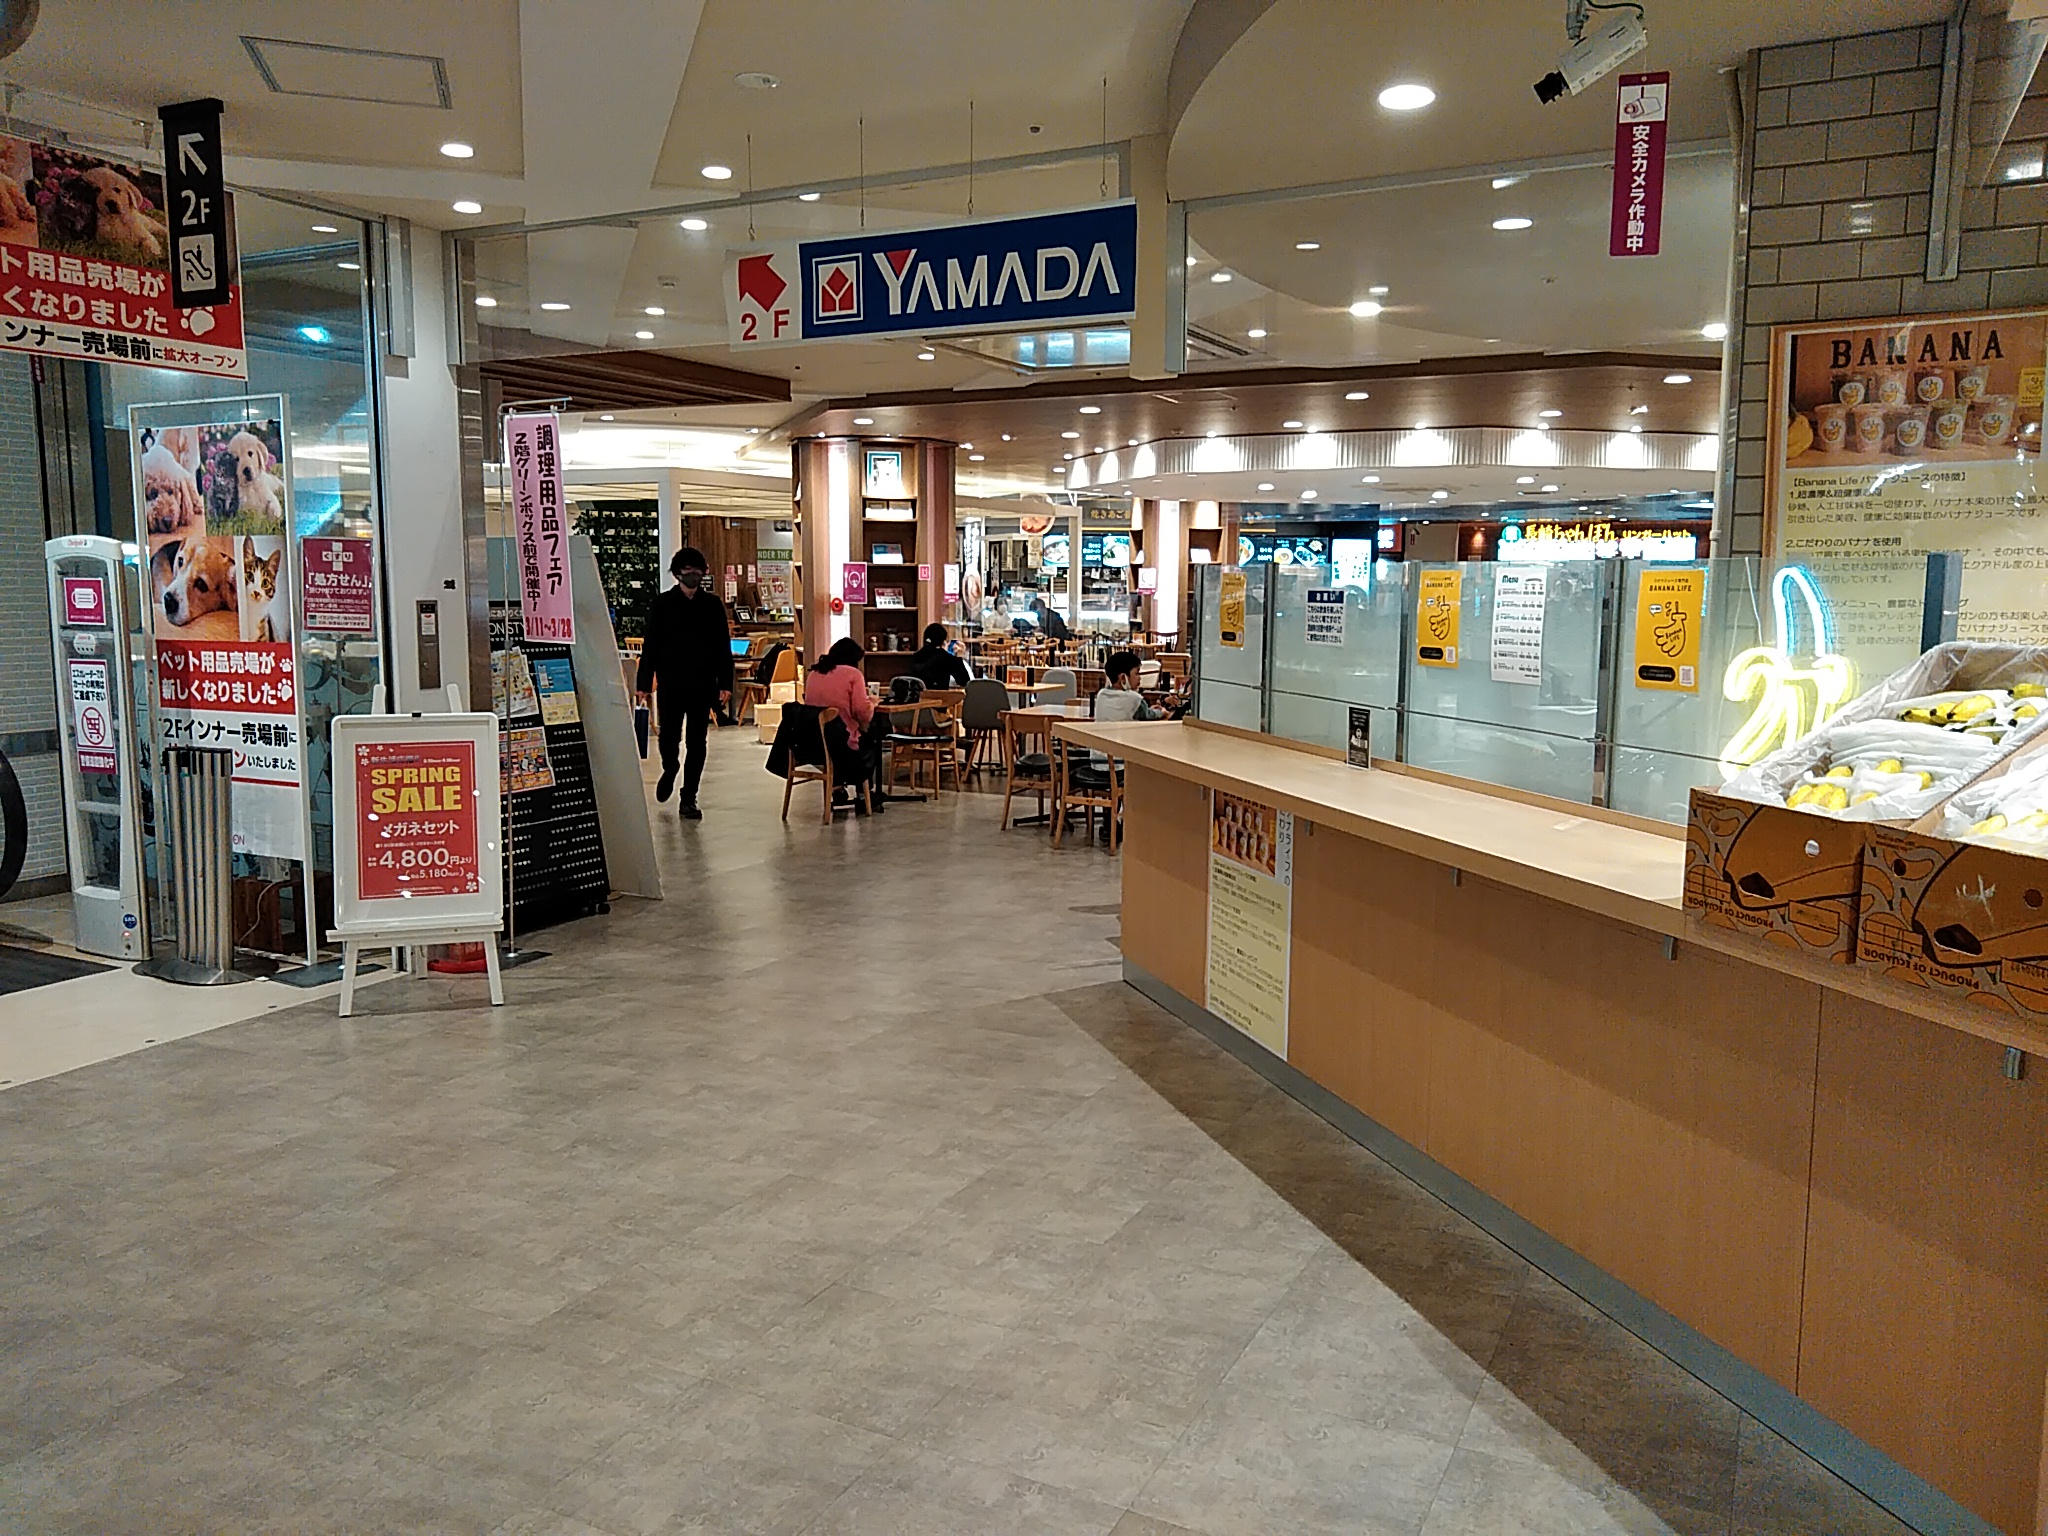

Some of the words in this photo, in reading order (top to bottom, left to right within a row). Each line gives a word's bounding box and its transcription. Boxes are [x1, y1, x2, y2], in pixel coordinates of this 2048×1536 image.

[1626, 125, 1650, 252] 安全カメラ作動中
[181, 190, 210, 226] 2F
[1, 246, 166, 298] ト用品売場が
[873, 242, 1120, 315] YAMADA
[3, 285, 168, 334] くなりました
[1830, 329, 2004, 369] BANANA
[536, 424, 563, 595] 調理用品フェア
[323, 552, 353, 561] くすり
[1502, 575, 1519, 584] Menu
[161, 650, 275, 674] ペット用品売場が
[162, 678, 277, 705] 新しくなりました
[163, 718, 298, 748] 2Fインナー売場前に
[371, 766, 461, 785] SPRING
[372, 785, 462, 813] SALE
[382, 820, 460, 837] メガネセット
[1687, 895, 1723, 914] ECUADOR
[1736, 910, 1774, 928] PRODUCT
[1863, 947, 1911, 969] ECUADOR
[1913, 961, 1928, 973] OF
[1929, 967, 1980, 989] PRODUCT
